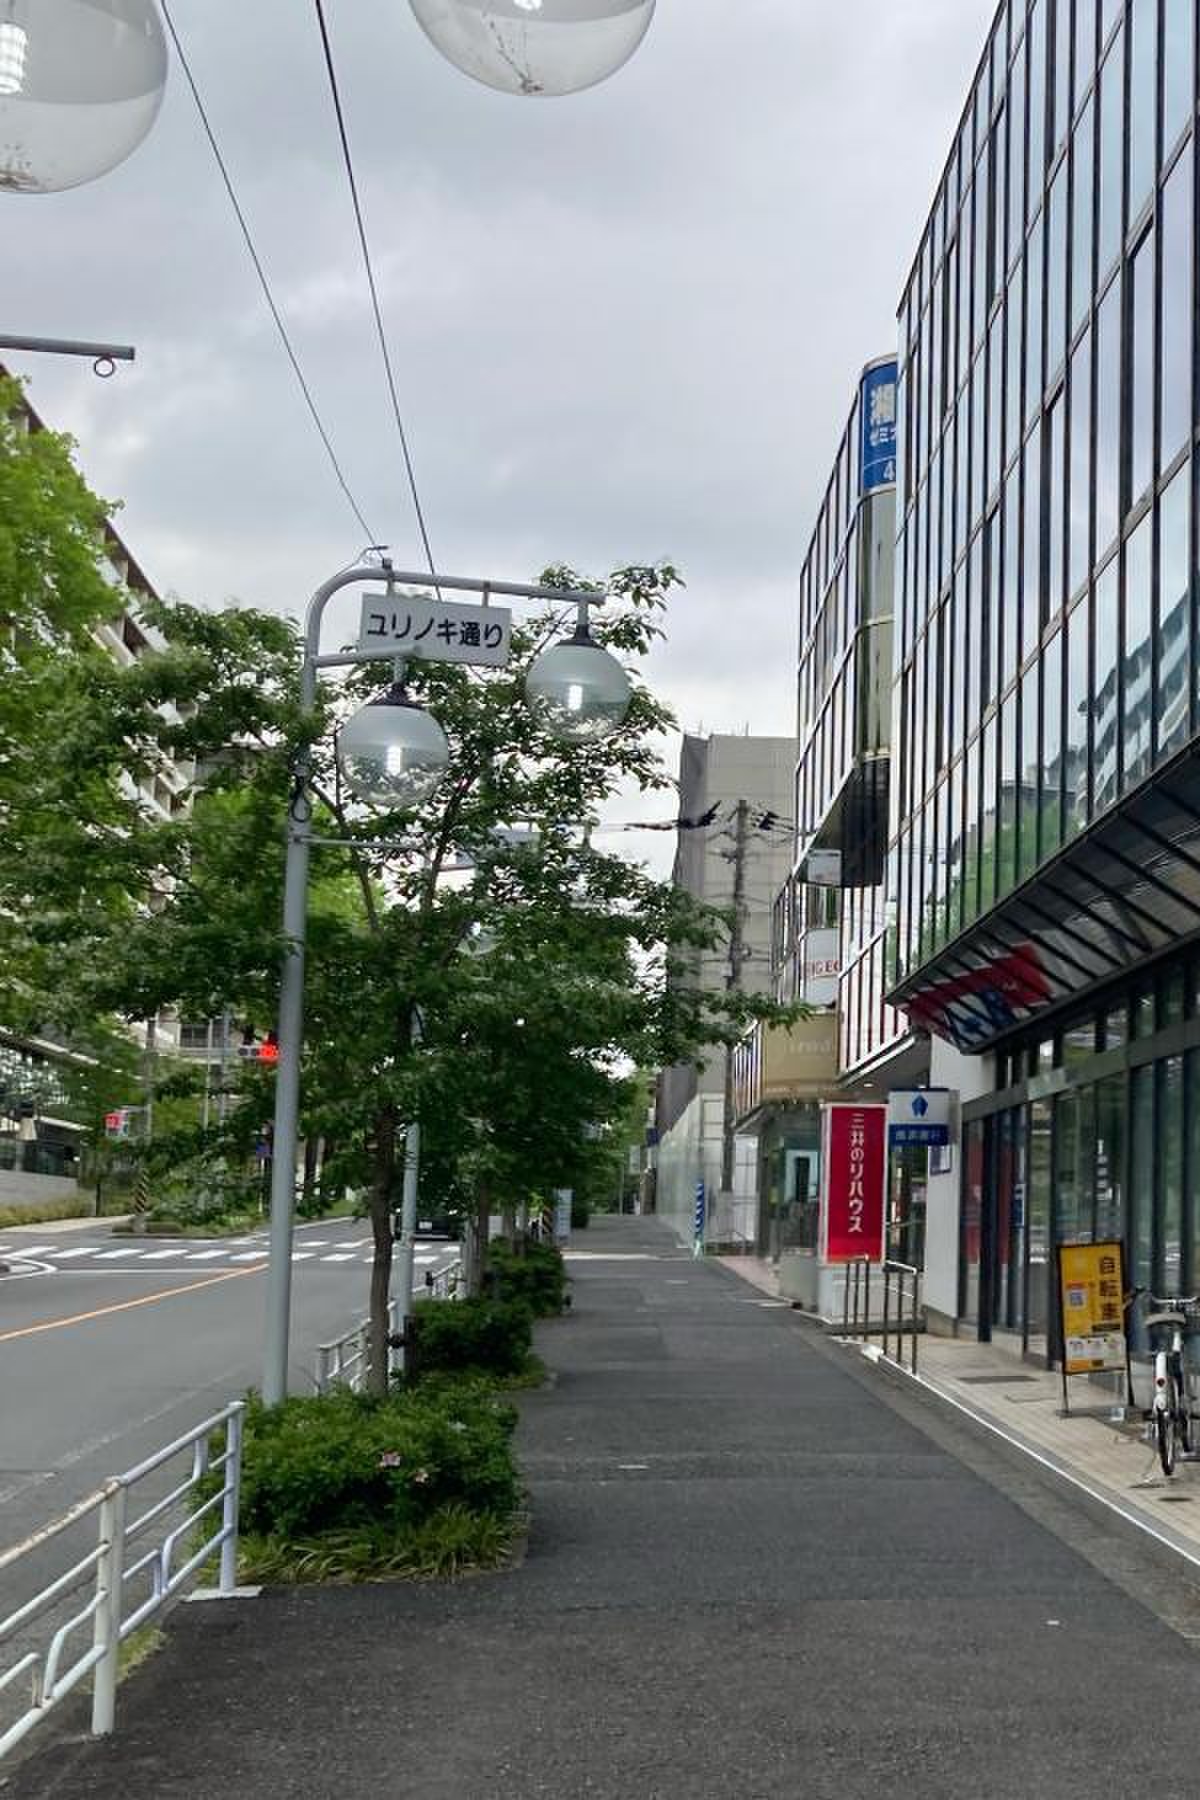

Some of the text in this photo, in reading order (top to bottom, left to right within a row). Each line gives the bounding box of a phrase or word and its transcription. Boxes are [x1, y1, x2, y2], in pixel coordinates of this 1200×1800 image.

[367, 613, 504, 649] ユリノキ通り
[848, 1113, 865, 1233] 三井のリハウス
